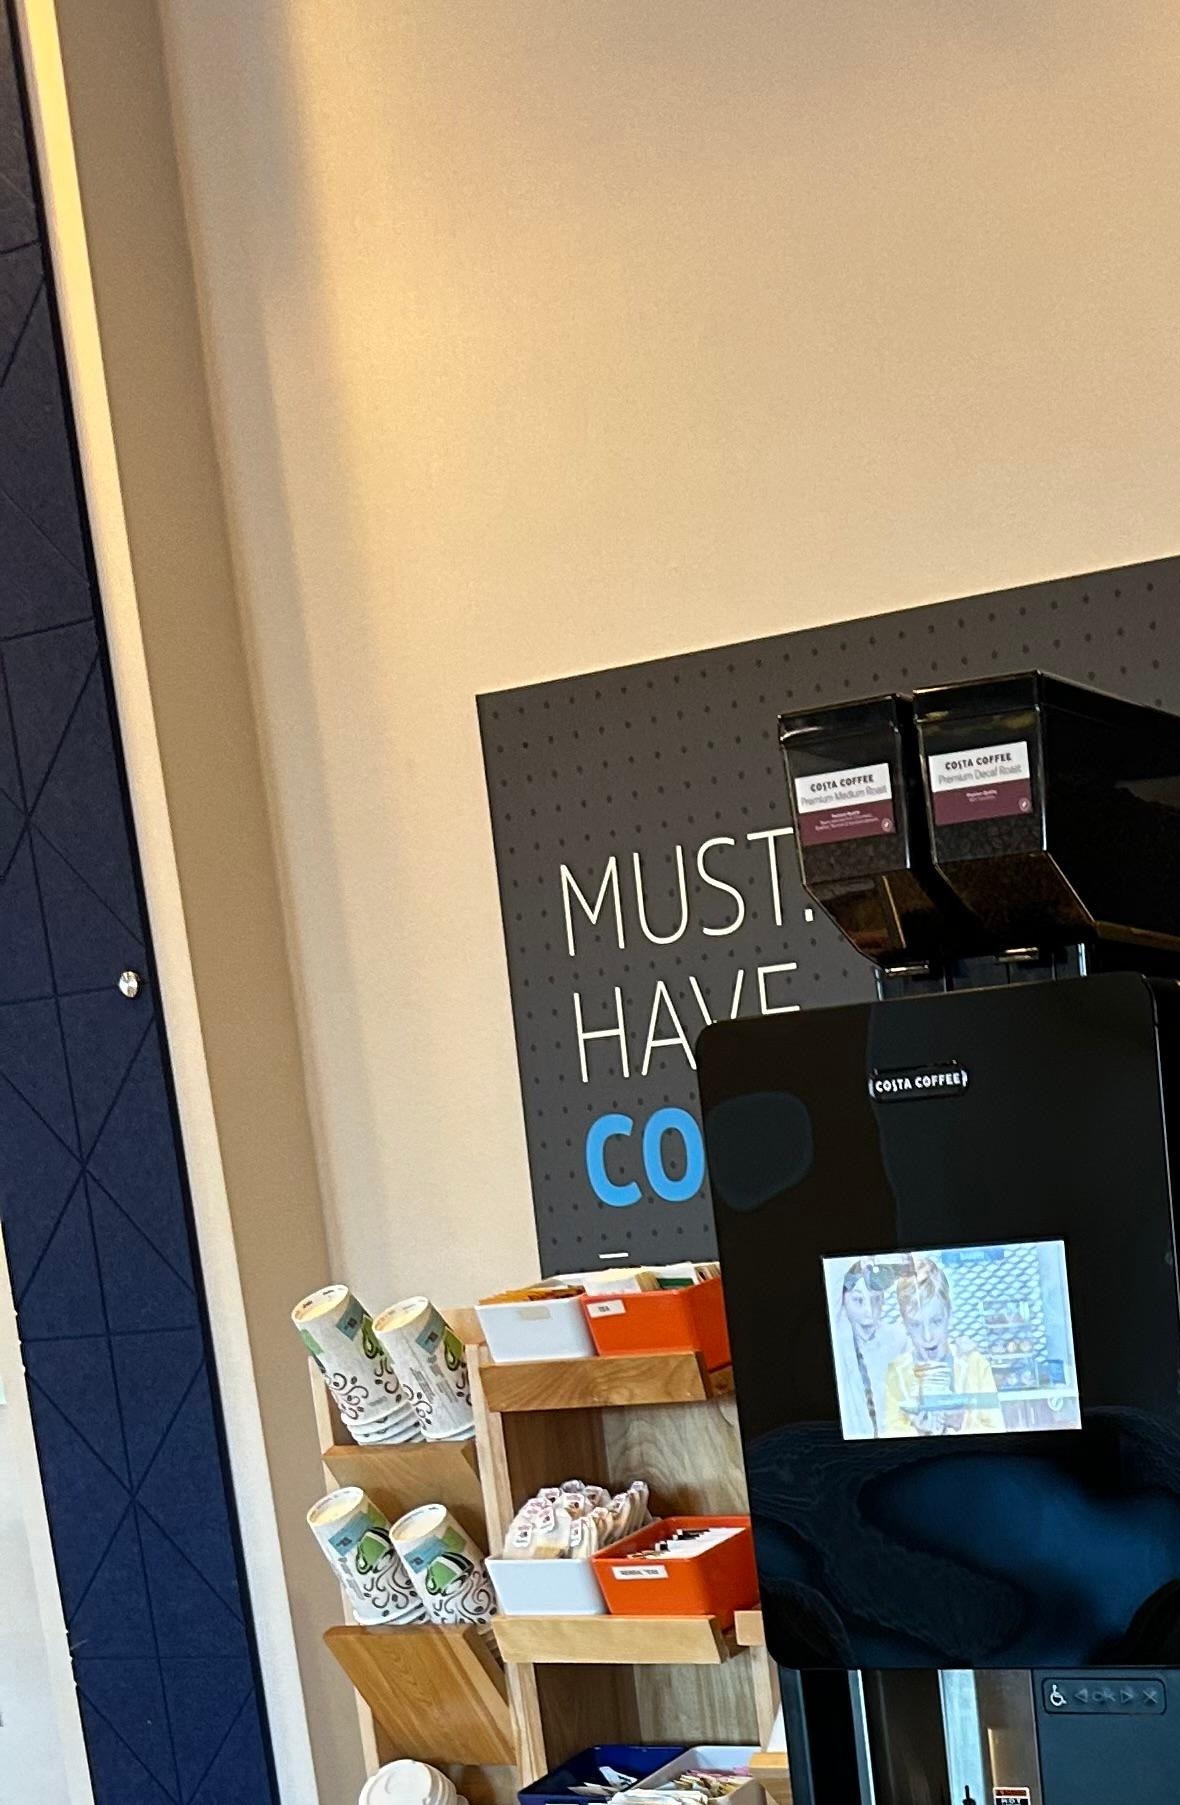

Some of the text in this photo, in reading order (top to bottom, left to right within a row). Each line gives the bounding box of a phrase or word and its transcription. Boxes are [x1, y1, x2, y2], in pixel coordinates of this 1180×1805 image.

[945, 752, 1012, 771] COSTA COFFEE
[810, 774, 875, 792] COSTA COFFEE
[938, 764, 1022, 785] Premium Decaf Roast
[801, 794, 834, 807] Premium
[865, 784, 888, 796] Roast
[560, 827, 814, 957] MUST.
[875, 1072, 961, 1093] COSTA COFFEE
